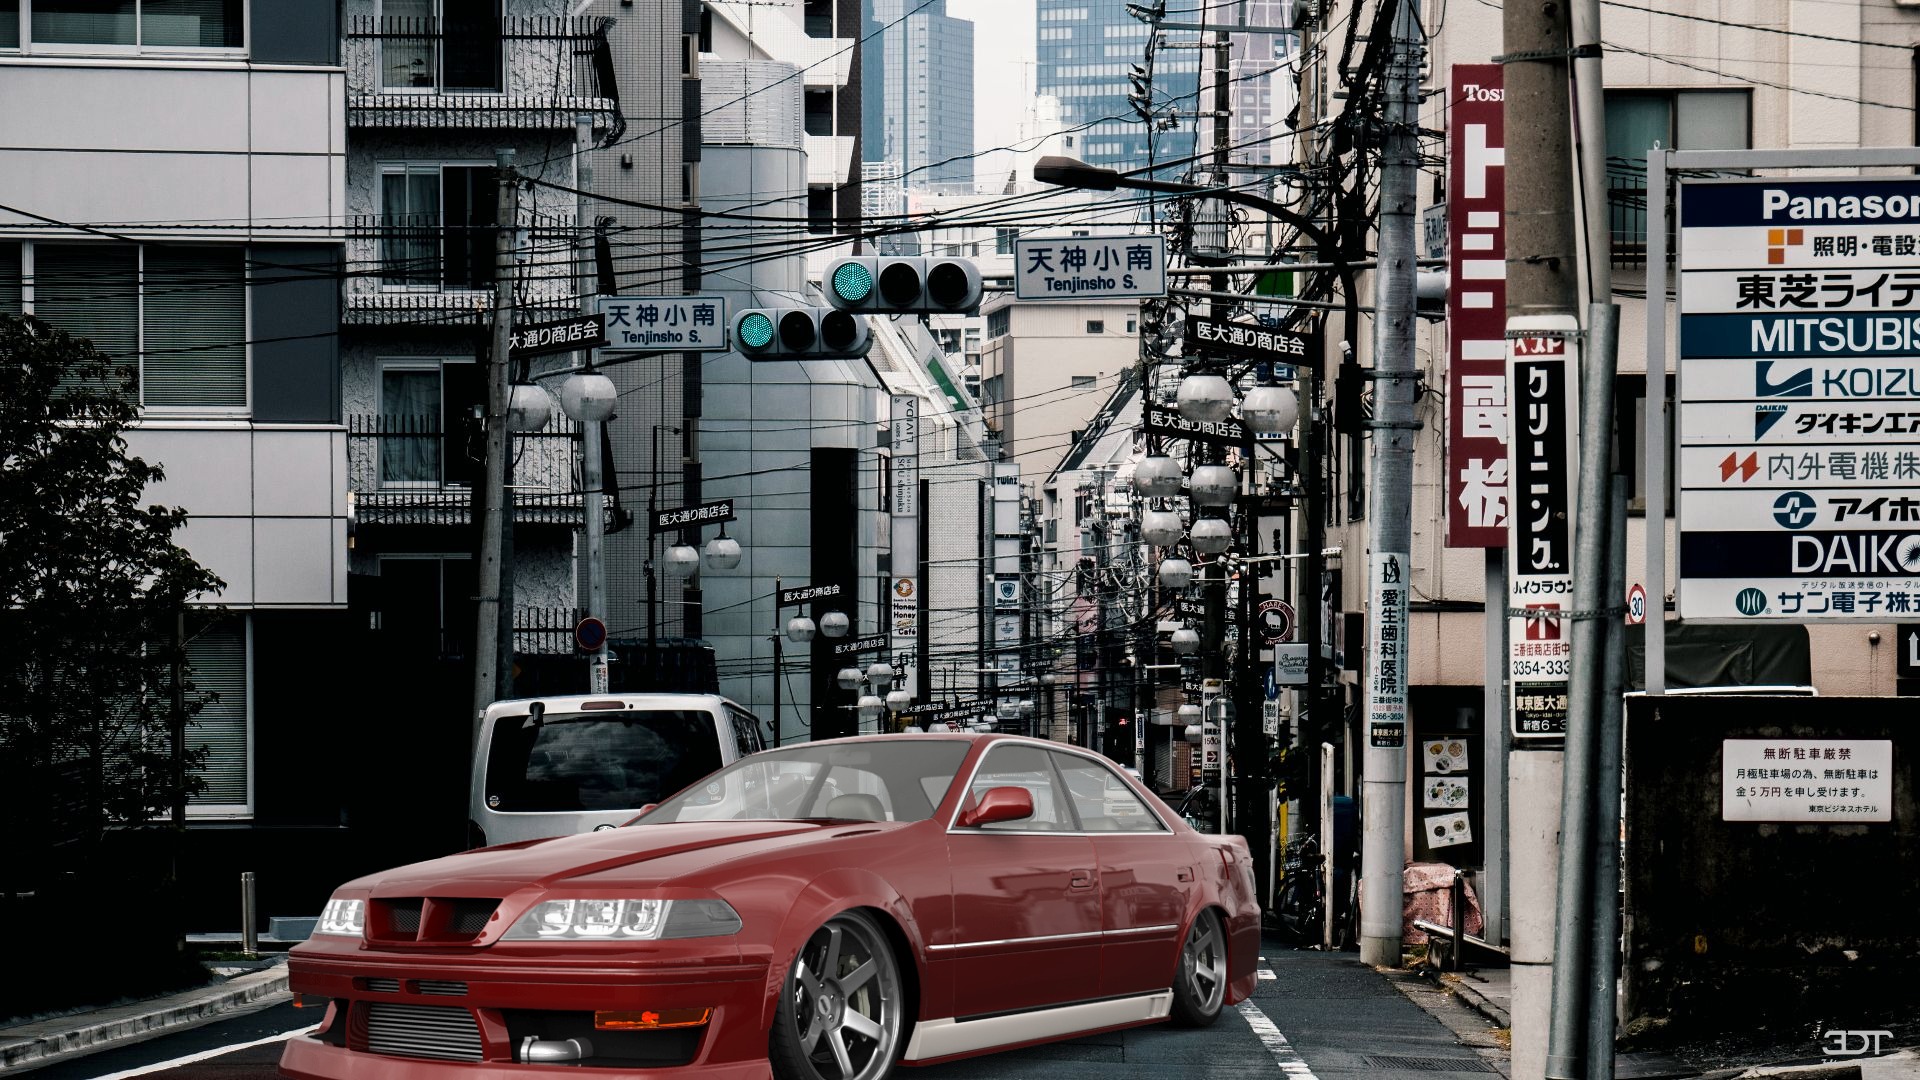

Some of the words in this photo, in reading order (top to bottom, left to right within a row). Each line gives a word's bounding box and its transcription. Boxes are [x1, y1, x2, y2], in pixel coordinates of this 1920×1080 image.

[1813, 235, 1920, 257] 照明・電設
[1027, 244, 1152, 273] 天神小南
[1045, 274, 1116, 293] Tenjinsho
[1123, 275, 1137, 290] S.
[608, 303, 716, 328] 天神小南
[622, 330, 683, 345] Tenjinsho
[689, 330, 702, 343] S.
[1196, 321, 1305, 356] 医大通り商店会
[906, 399, 914, 443] LIVIDA
[1768, 451, 1920, 481] 内外電機株
[659, 503, 730, 526] 医大通り商店会
[783, 584, 841, 602] 医大通り商店会
[893, 603, 916, 611] Honey
[893, 611, 916, 619] Honey
[1632, 600, 1643, 617] 30
[898, 627, 916, 636] Café
[835, 637, 885, 654] 医大通り商店会
[1380, 588, 1399, 694] 愛生歯科医院
[1763, 747, 1852, 760] 無断駐車厳禁
[1736, 768, 1879, 780] 月極駐車場の為、無断駐車は
[1808, 804, 1878, 813] 東京ビジネスホテル
